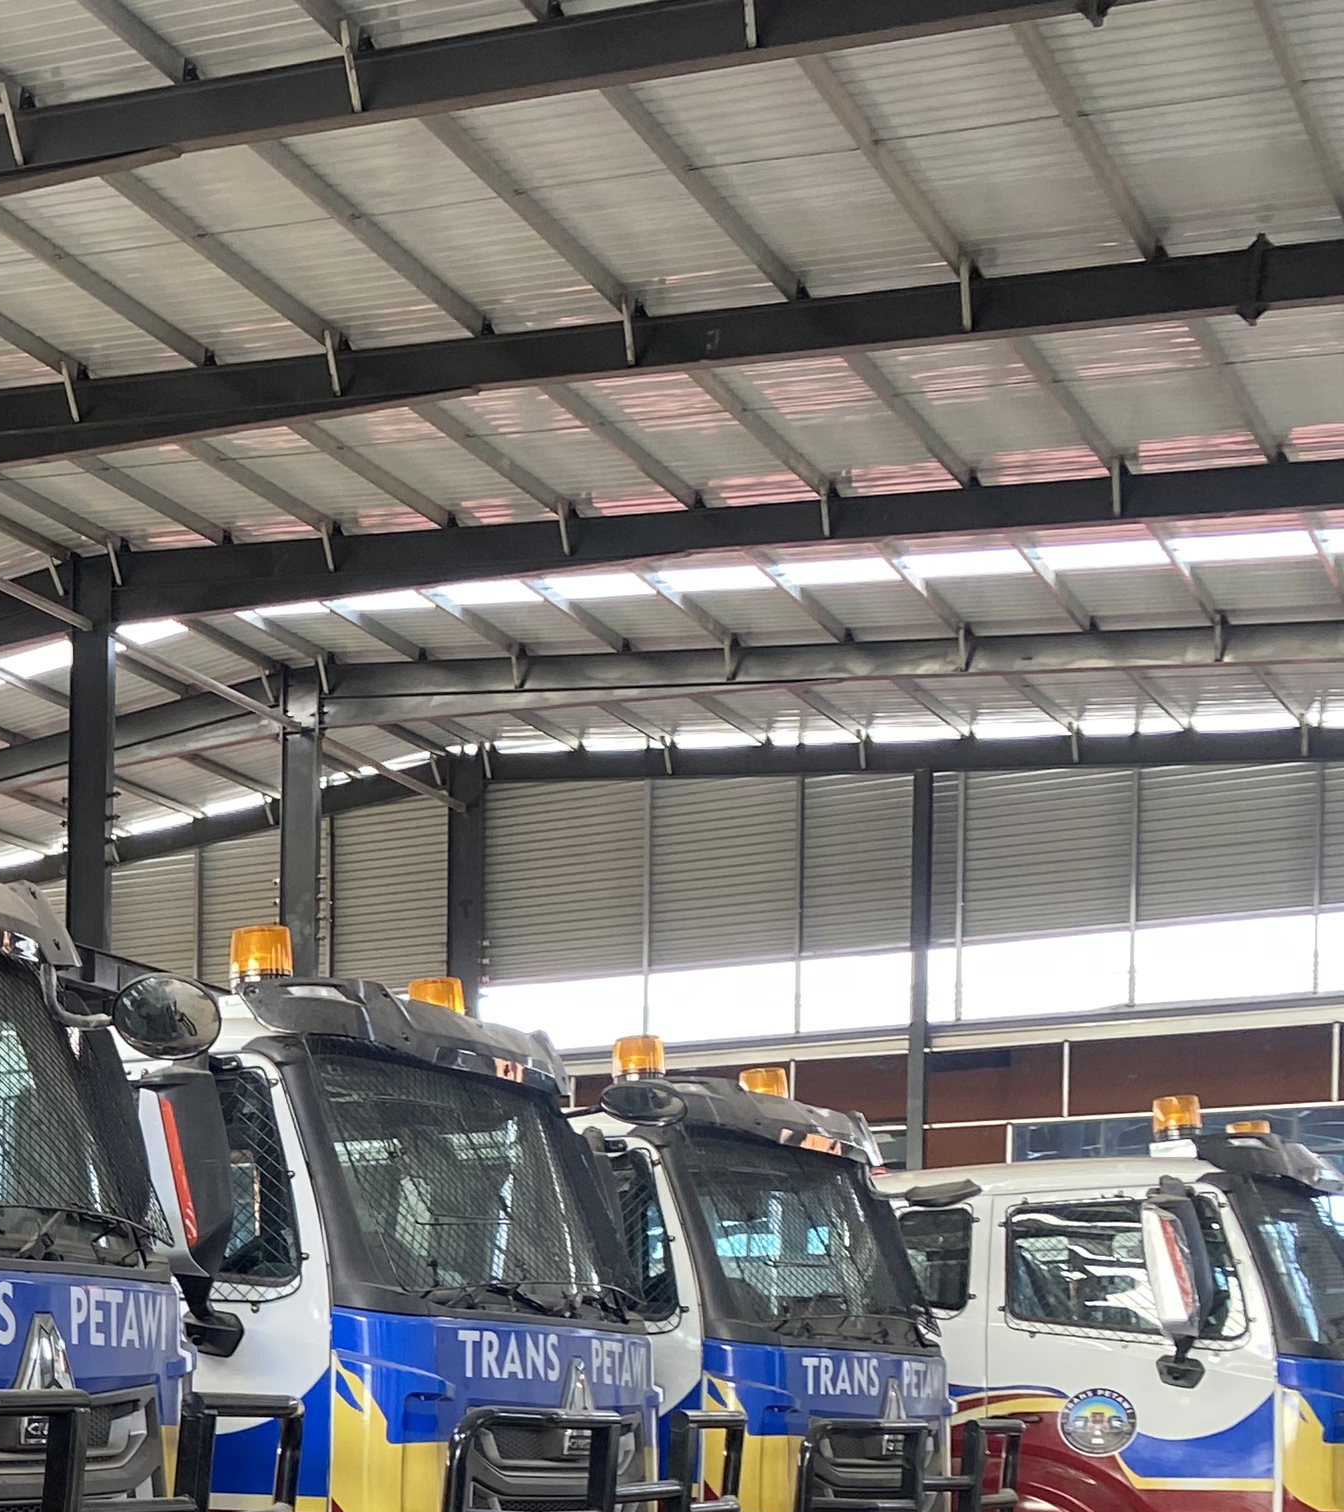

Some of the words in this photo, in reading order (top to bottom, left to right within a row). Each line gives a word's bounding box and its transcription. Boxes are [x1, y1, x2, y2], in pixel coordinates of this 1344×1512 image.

[69, 1285, 166, 1351] PETAWI
[457, 1330, 560, 1382] TRANS
[591, 1338, 646, 1388] PETAWI
[802, 1357, 880, 1396] TRANS
